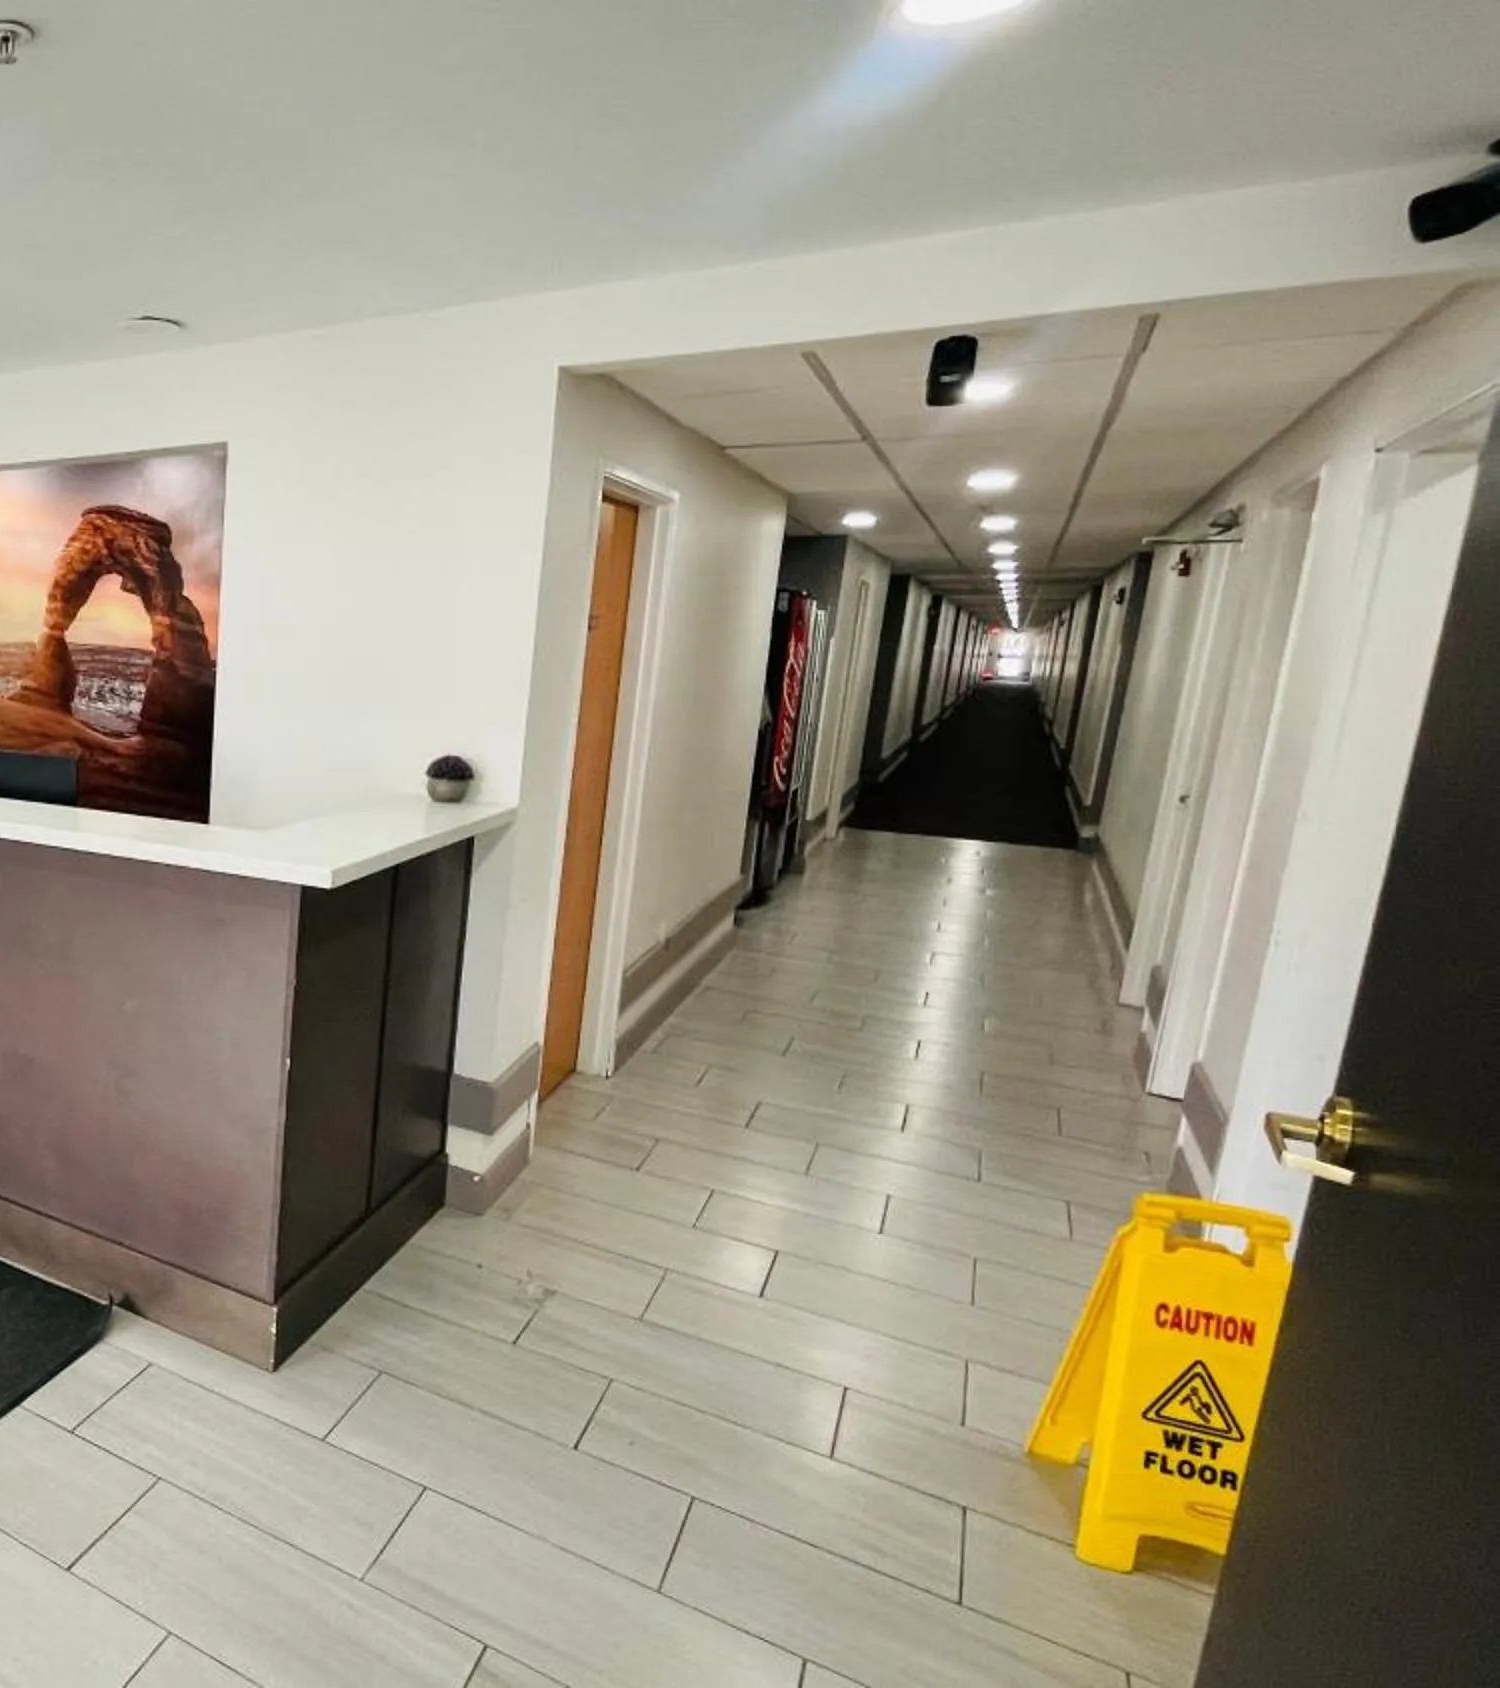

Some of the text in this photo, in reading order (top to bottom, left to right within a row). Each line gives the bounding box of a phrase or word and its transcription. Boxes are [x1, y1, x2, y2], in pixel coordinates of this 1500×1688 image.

[1155, 1302, 1255, 1346] CAUTION
[1162, 1430, 1223, 1460] WET
[1143, 1450, 1238, 1491] FLOOR
